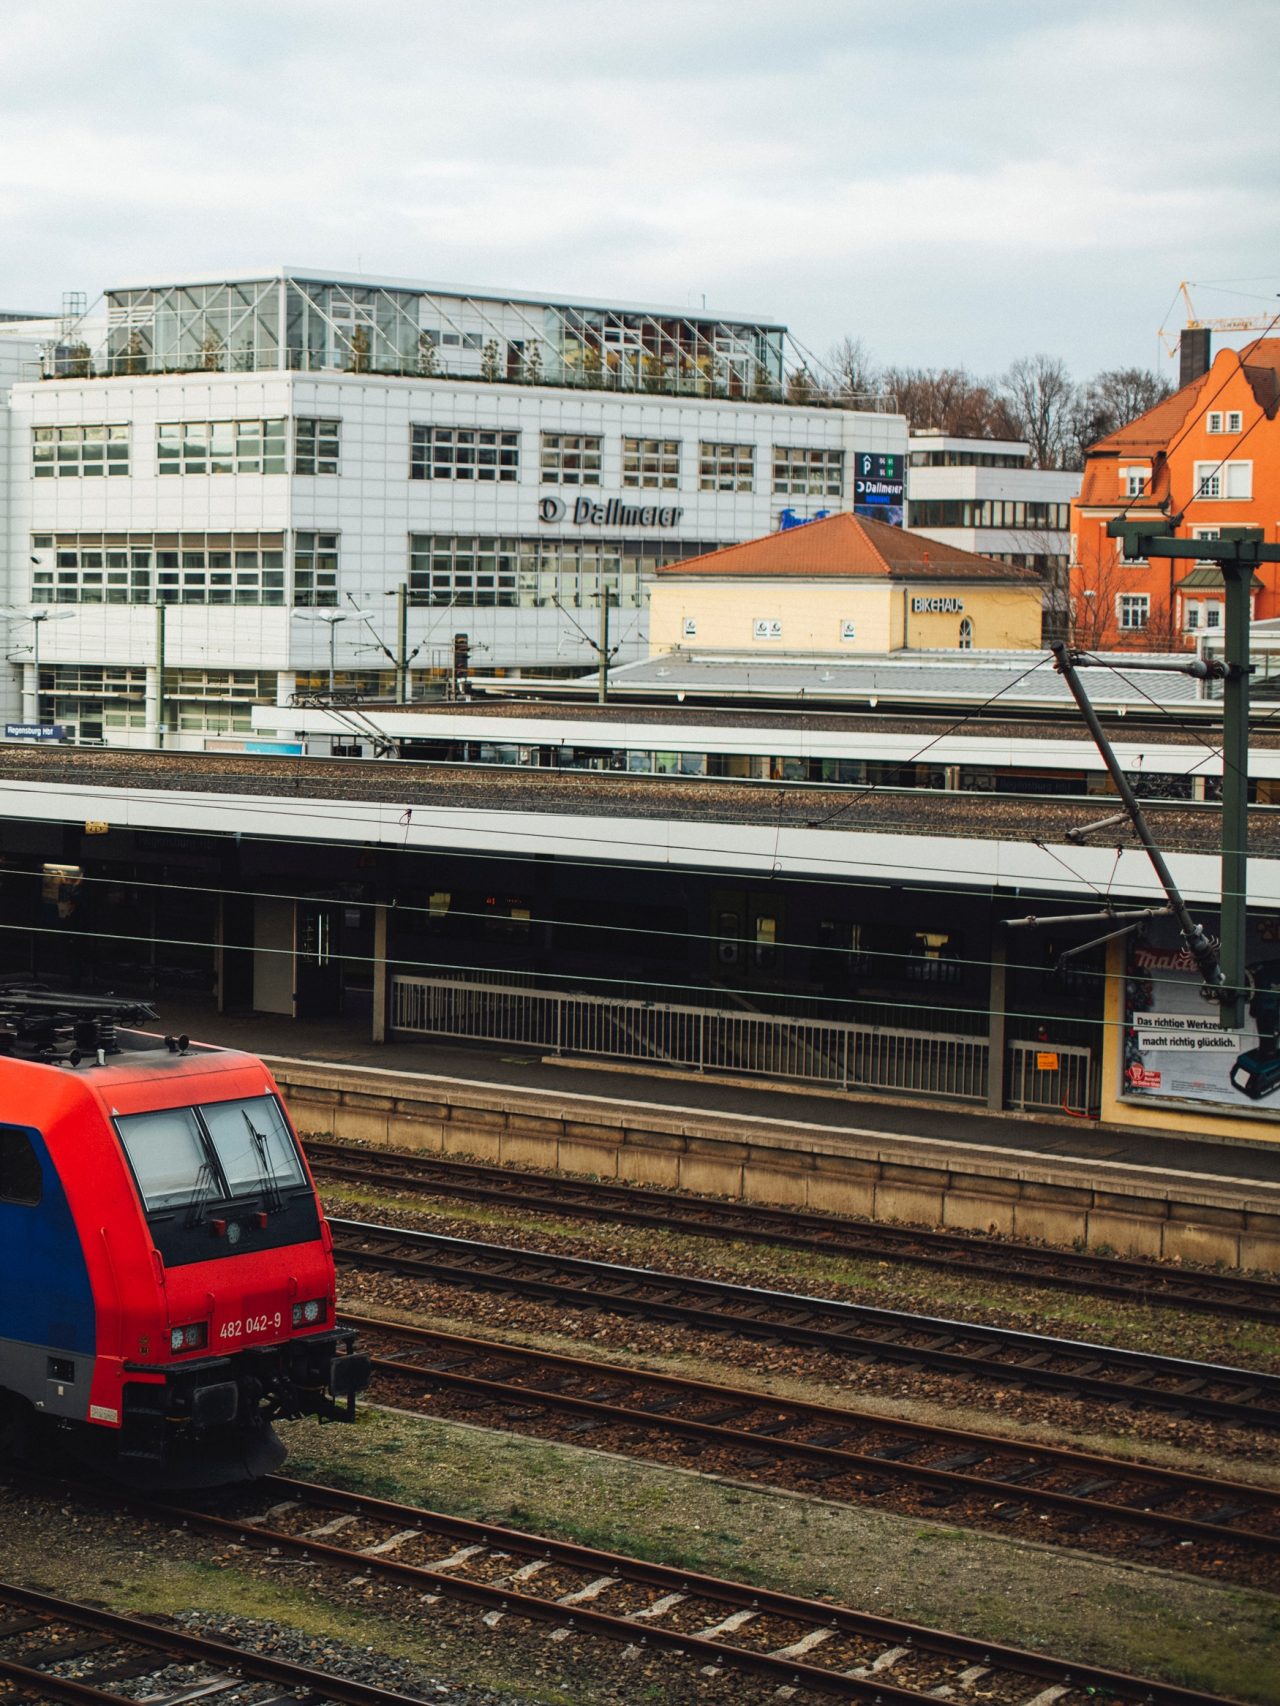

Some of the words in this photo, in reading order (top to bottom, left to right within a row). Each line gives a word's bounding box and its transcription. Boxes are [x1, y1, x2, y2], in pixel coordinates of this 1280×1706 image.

[865, 481, 903, 495] Dallmeier
[574, 497, 684, 527] Dallmeier
[911, 598, 964, 613] BIKEHAUS
[7, 726, 41, 737] Regensburg
[42, 728, 53, 736] Hbf
[1137, 1017, 1152, 1026] Das
[1154, 1018, 1185, 1028] richtige
[1142, 1037, 1168, 1046] macht
[1169, 1036, 1195, 1048] richtig
[1197, 1037, 1236, 1049] glücklich.
[220, 1320, 242, 1338] 482
[246, 1312, 281, 1334] 042-9
